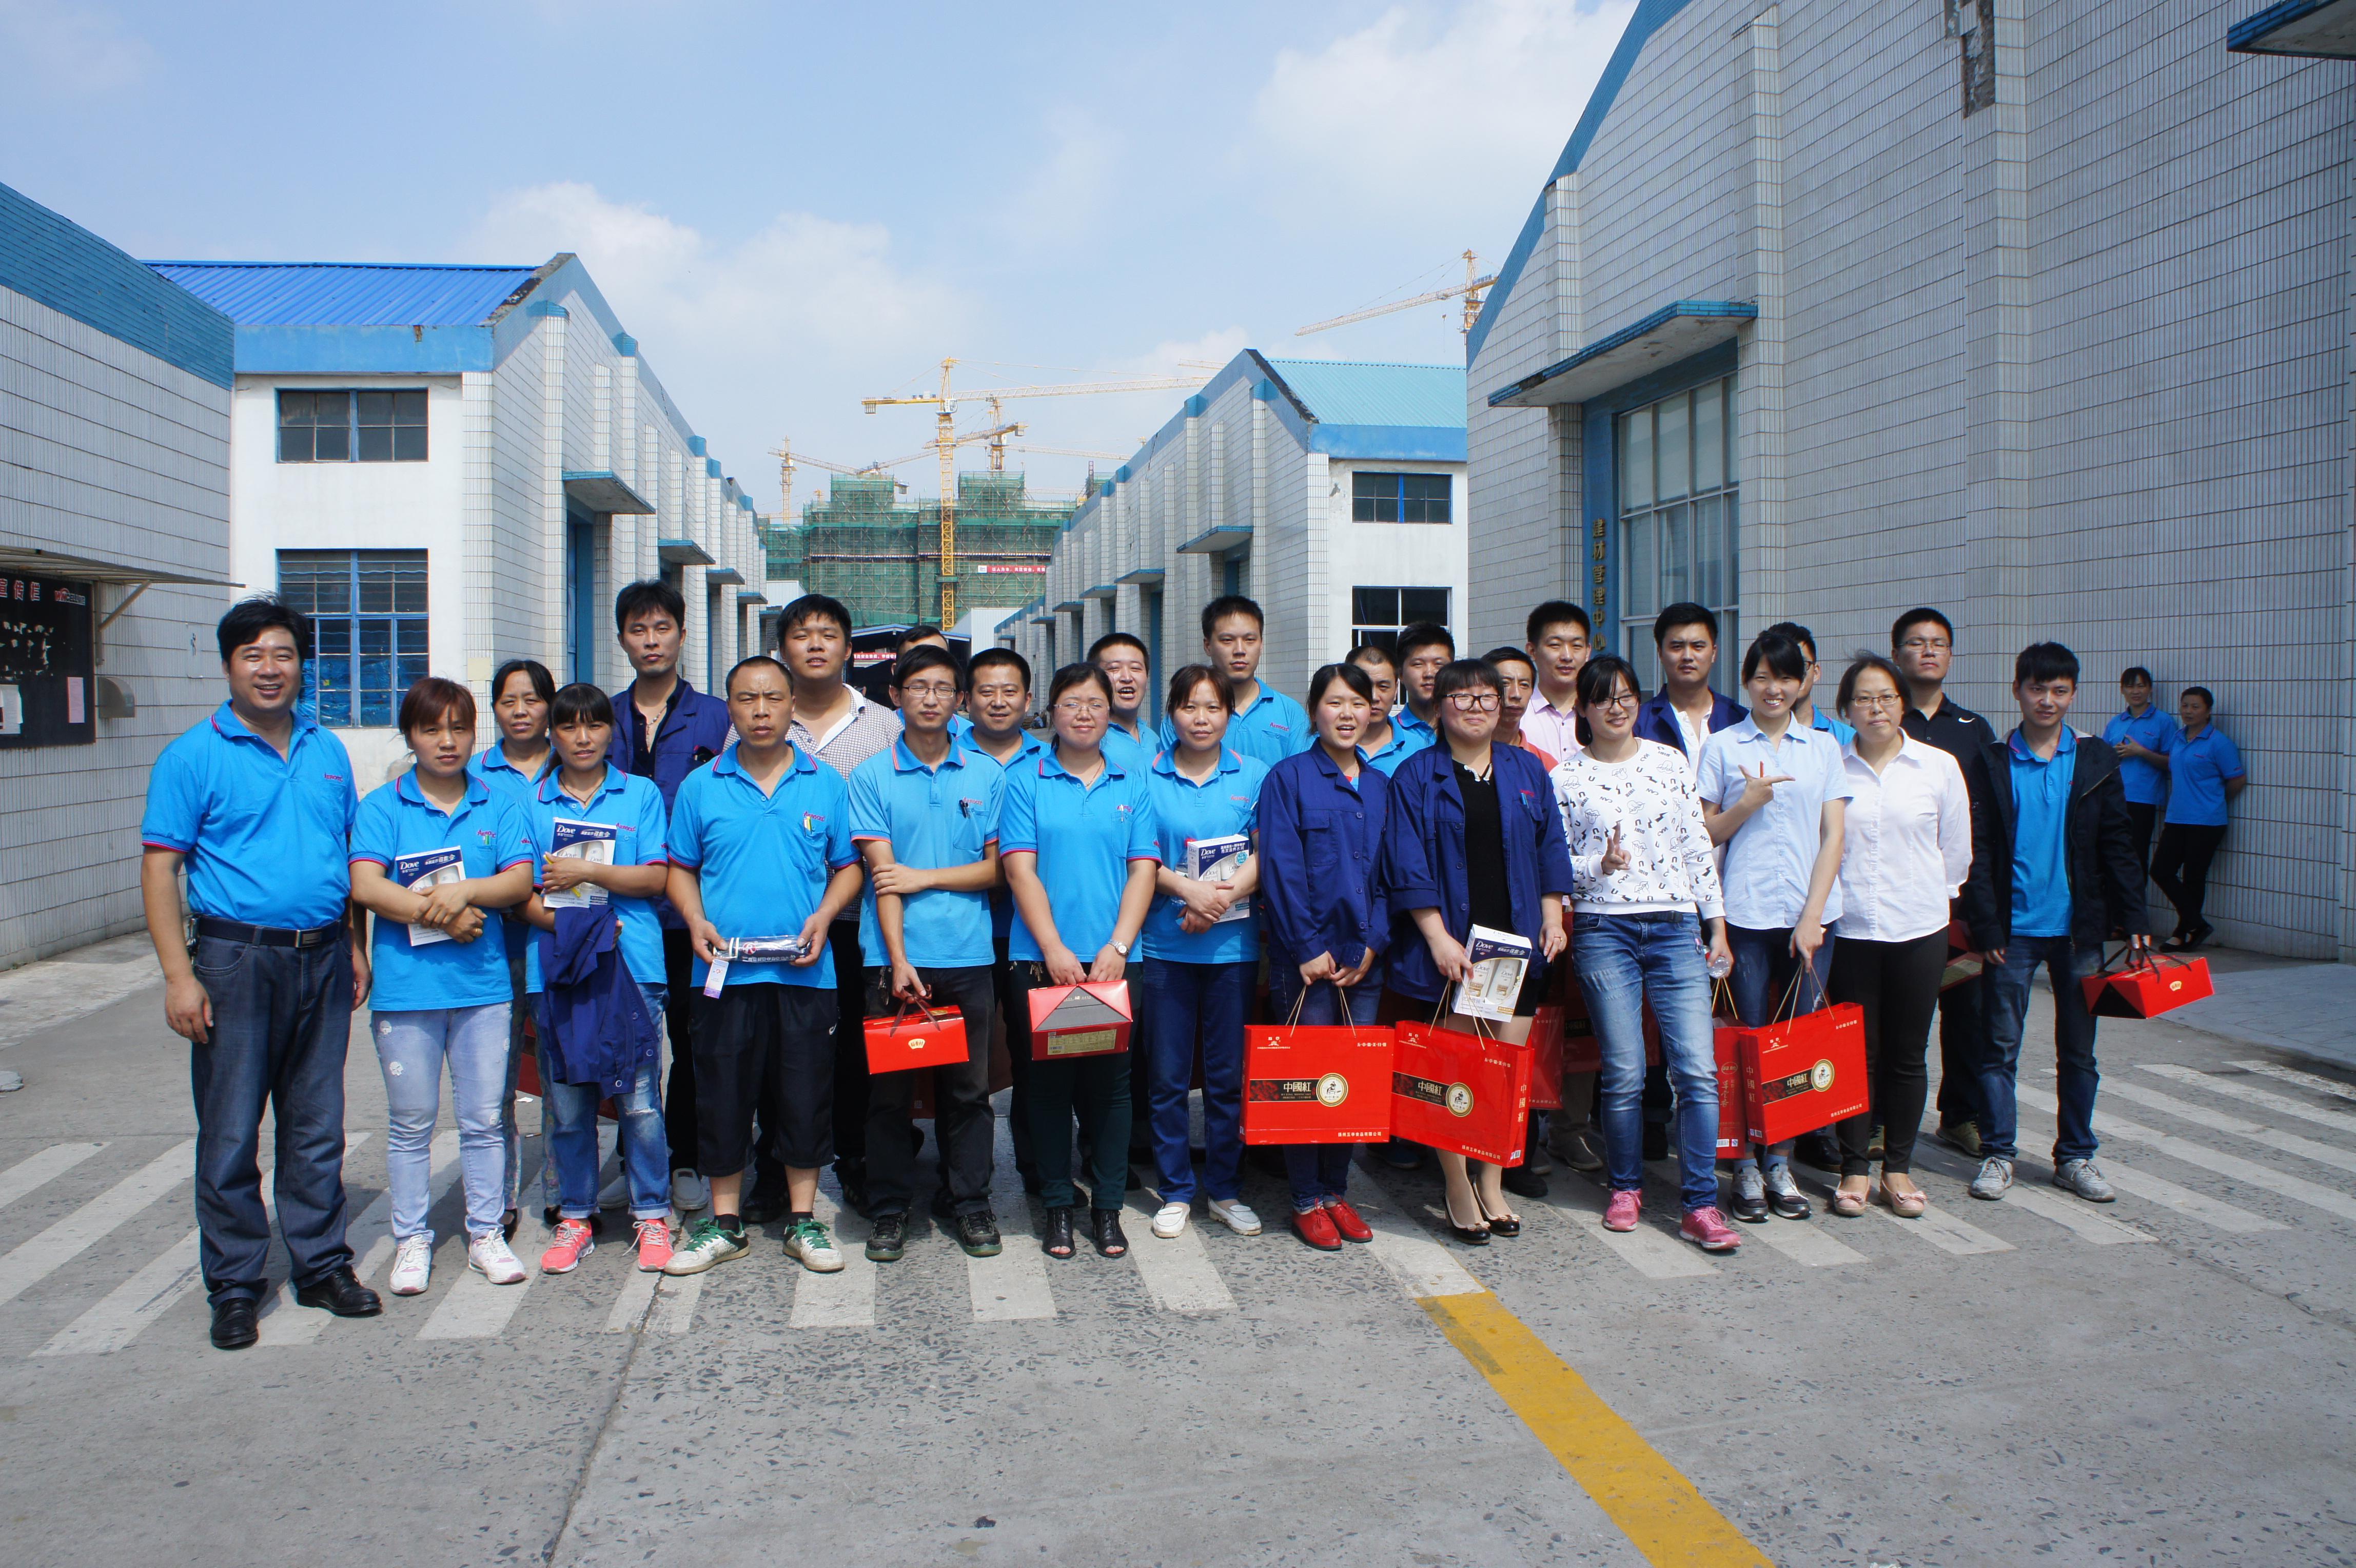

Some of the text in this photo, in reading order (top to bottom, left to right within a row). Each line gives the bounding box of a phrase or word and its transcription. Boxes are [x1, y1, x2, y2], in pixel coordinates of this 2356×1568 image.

[1593, 518, 1605, 651] 建材管理中心
[557, 825, 576, 834] Dove
[400, 861, 419, 870] Dove
[1476, 940, 1494, 949] Dove
[1283, 1082, 1312, 1093] 中國紅
[1746, 1065, 1756, 1103] 中國紅
[1786, 1073, 1809, 1088] 中國紅
[1418, 1081, 1443, 1096] 中國紅
[1517, 1083, 1527, 1123] 中國紅
